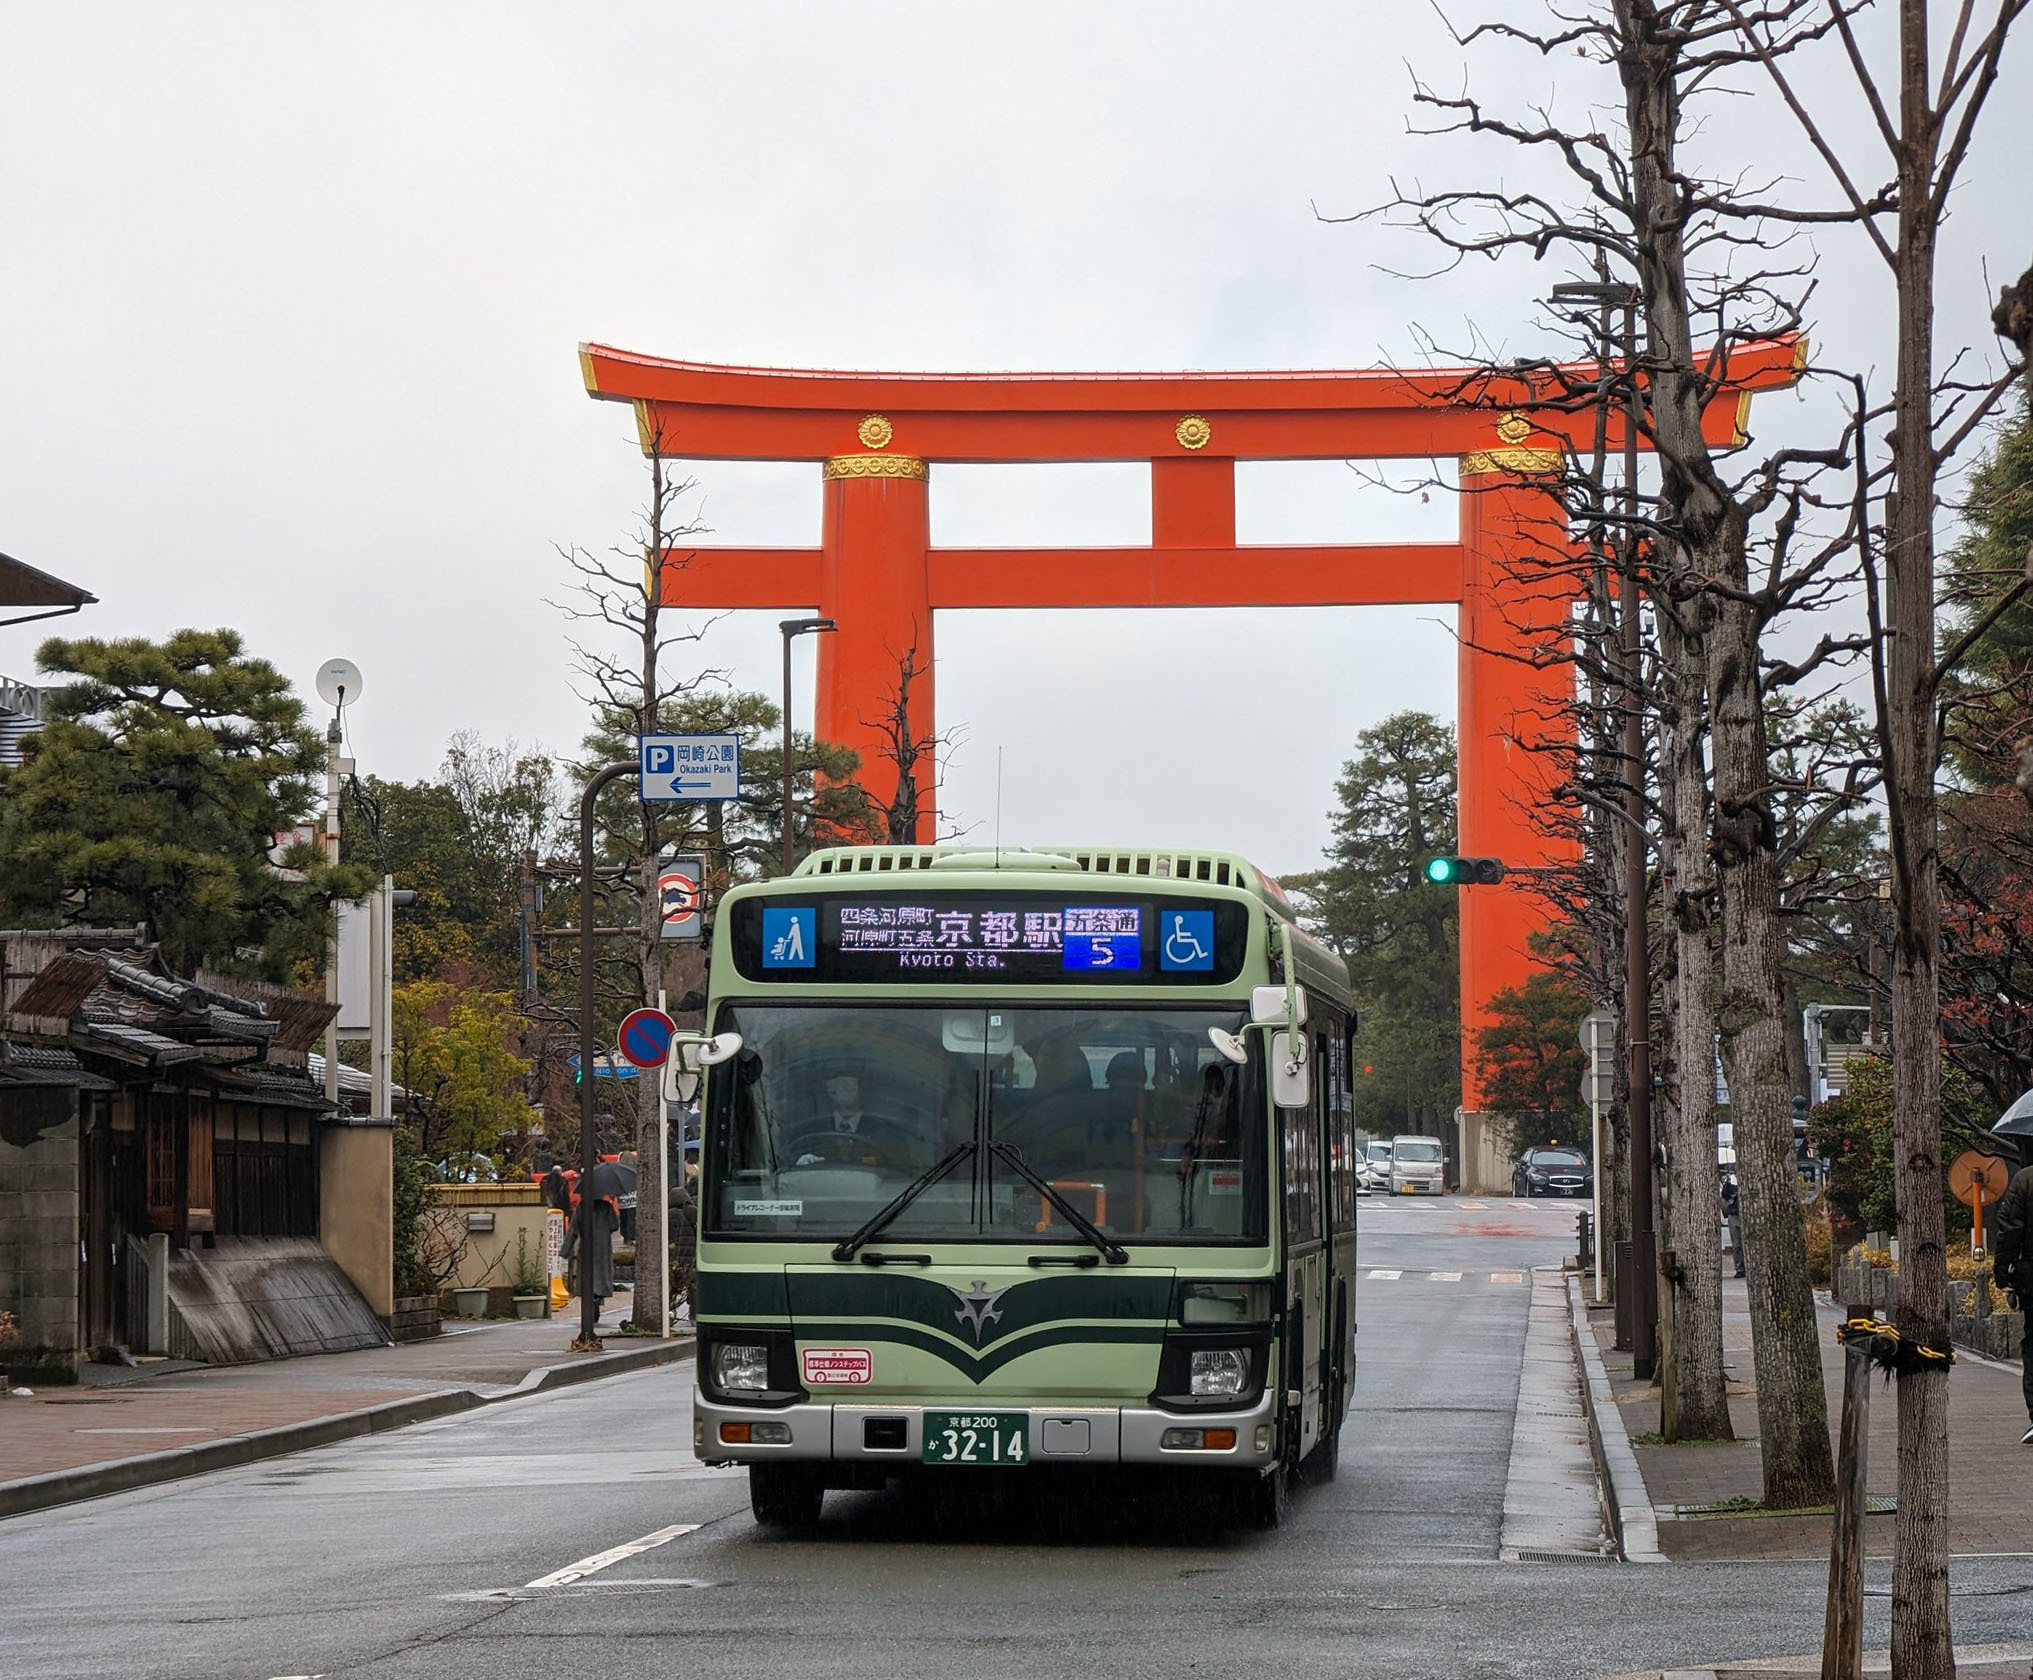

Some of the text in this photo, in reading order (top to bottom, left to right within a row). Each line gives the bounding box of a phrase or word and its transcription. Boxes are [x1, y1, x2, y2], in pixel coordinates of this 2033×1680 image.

[651, 748, 669, 771] P
[678, 745, 734, 762] 岡崎公園
[680, 764, 732, 773] Okazaki Park
[840, 907, 935, 926] 四条河原町
[841, 929, 935, 947] 河原町五条
[936, 911, 1063, 948] 京都駅
[899, 951, 1006, 967] Kyoto Sta.
[1091, 937, 1114, 965] 5
[928, 1430, 1023, 1461] か 32-14
